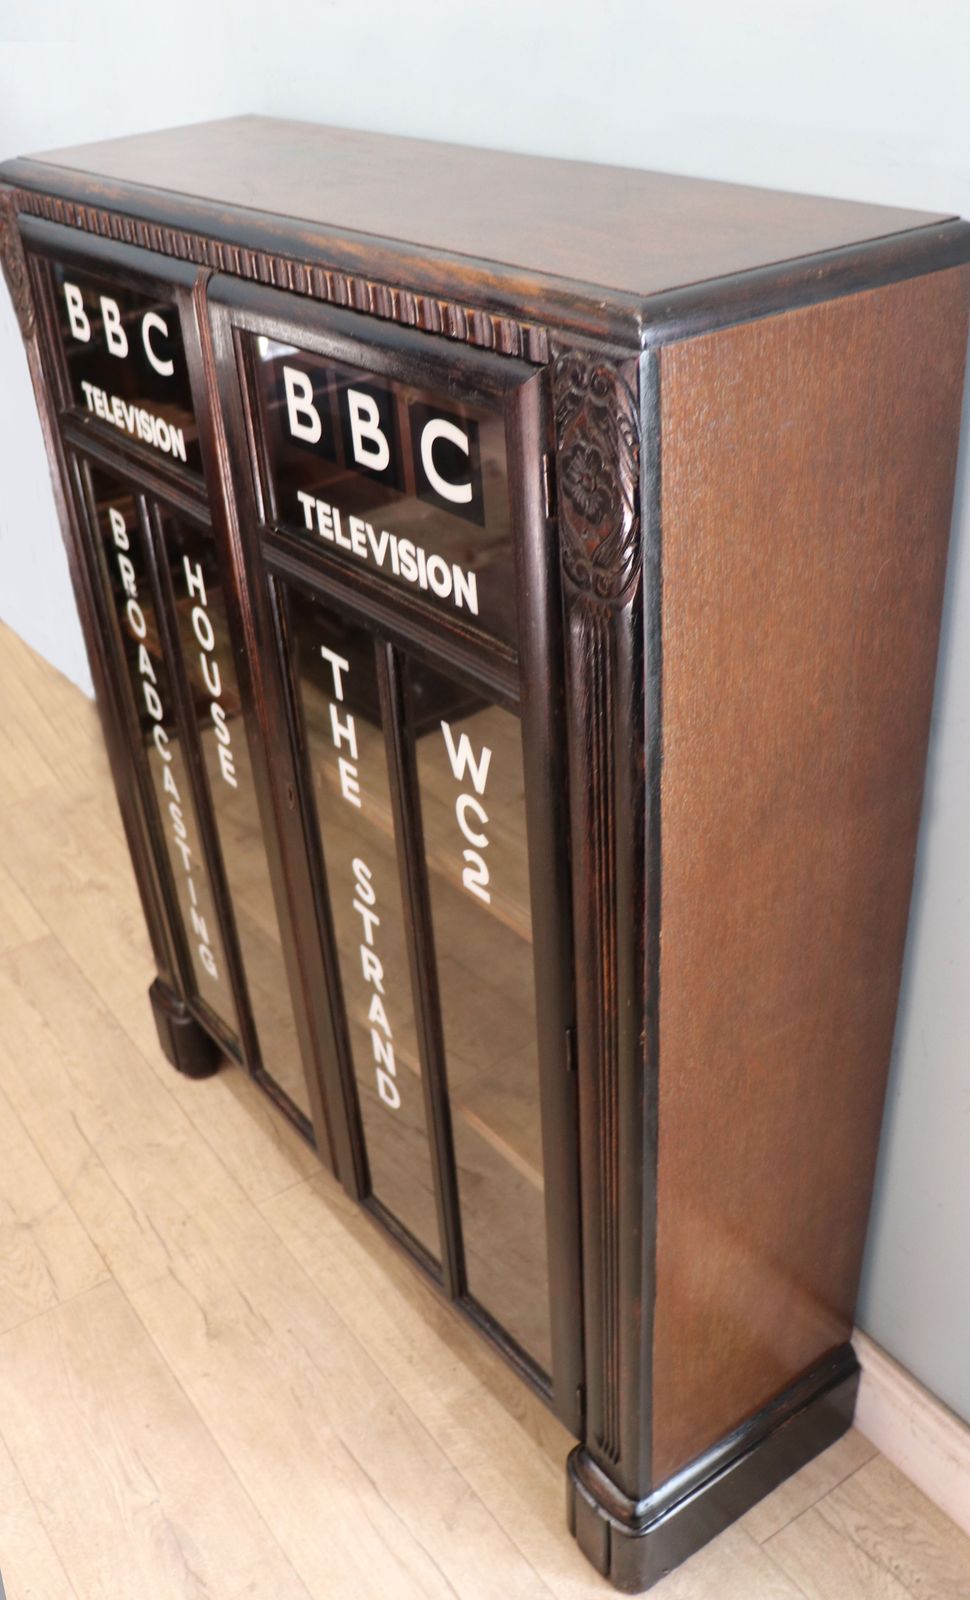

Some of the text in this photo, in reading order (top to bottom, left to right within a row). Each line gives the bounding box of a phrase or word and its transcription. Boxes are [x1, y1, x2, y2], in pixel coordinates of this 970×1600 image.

[63, 282, 175, 377] BBC
[81, 381, 187, 462] TELEVISION
[283, 366, 473, 504] BBC
[297, 491, 478, 616] TELEVISION
[109, 508, 218, 979] BROADCASTING
[183, 555, 238, 788] HOUSE
[321, 645, 401, 1110] THE STRAND
[441, 720, 493, 904] WC2
